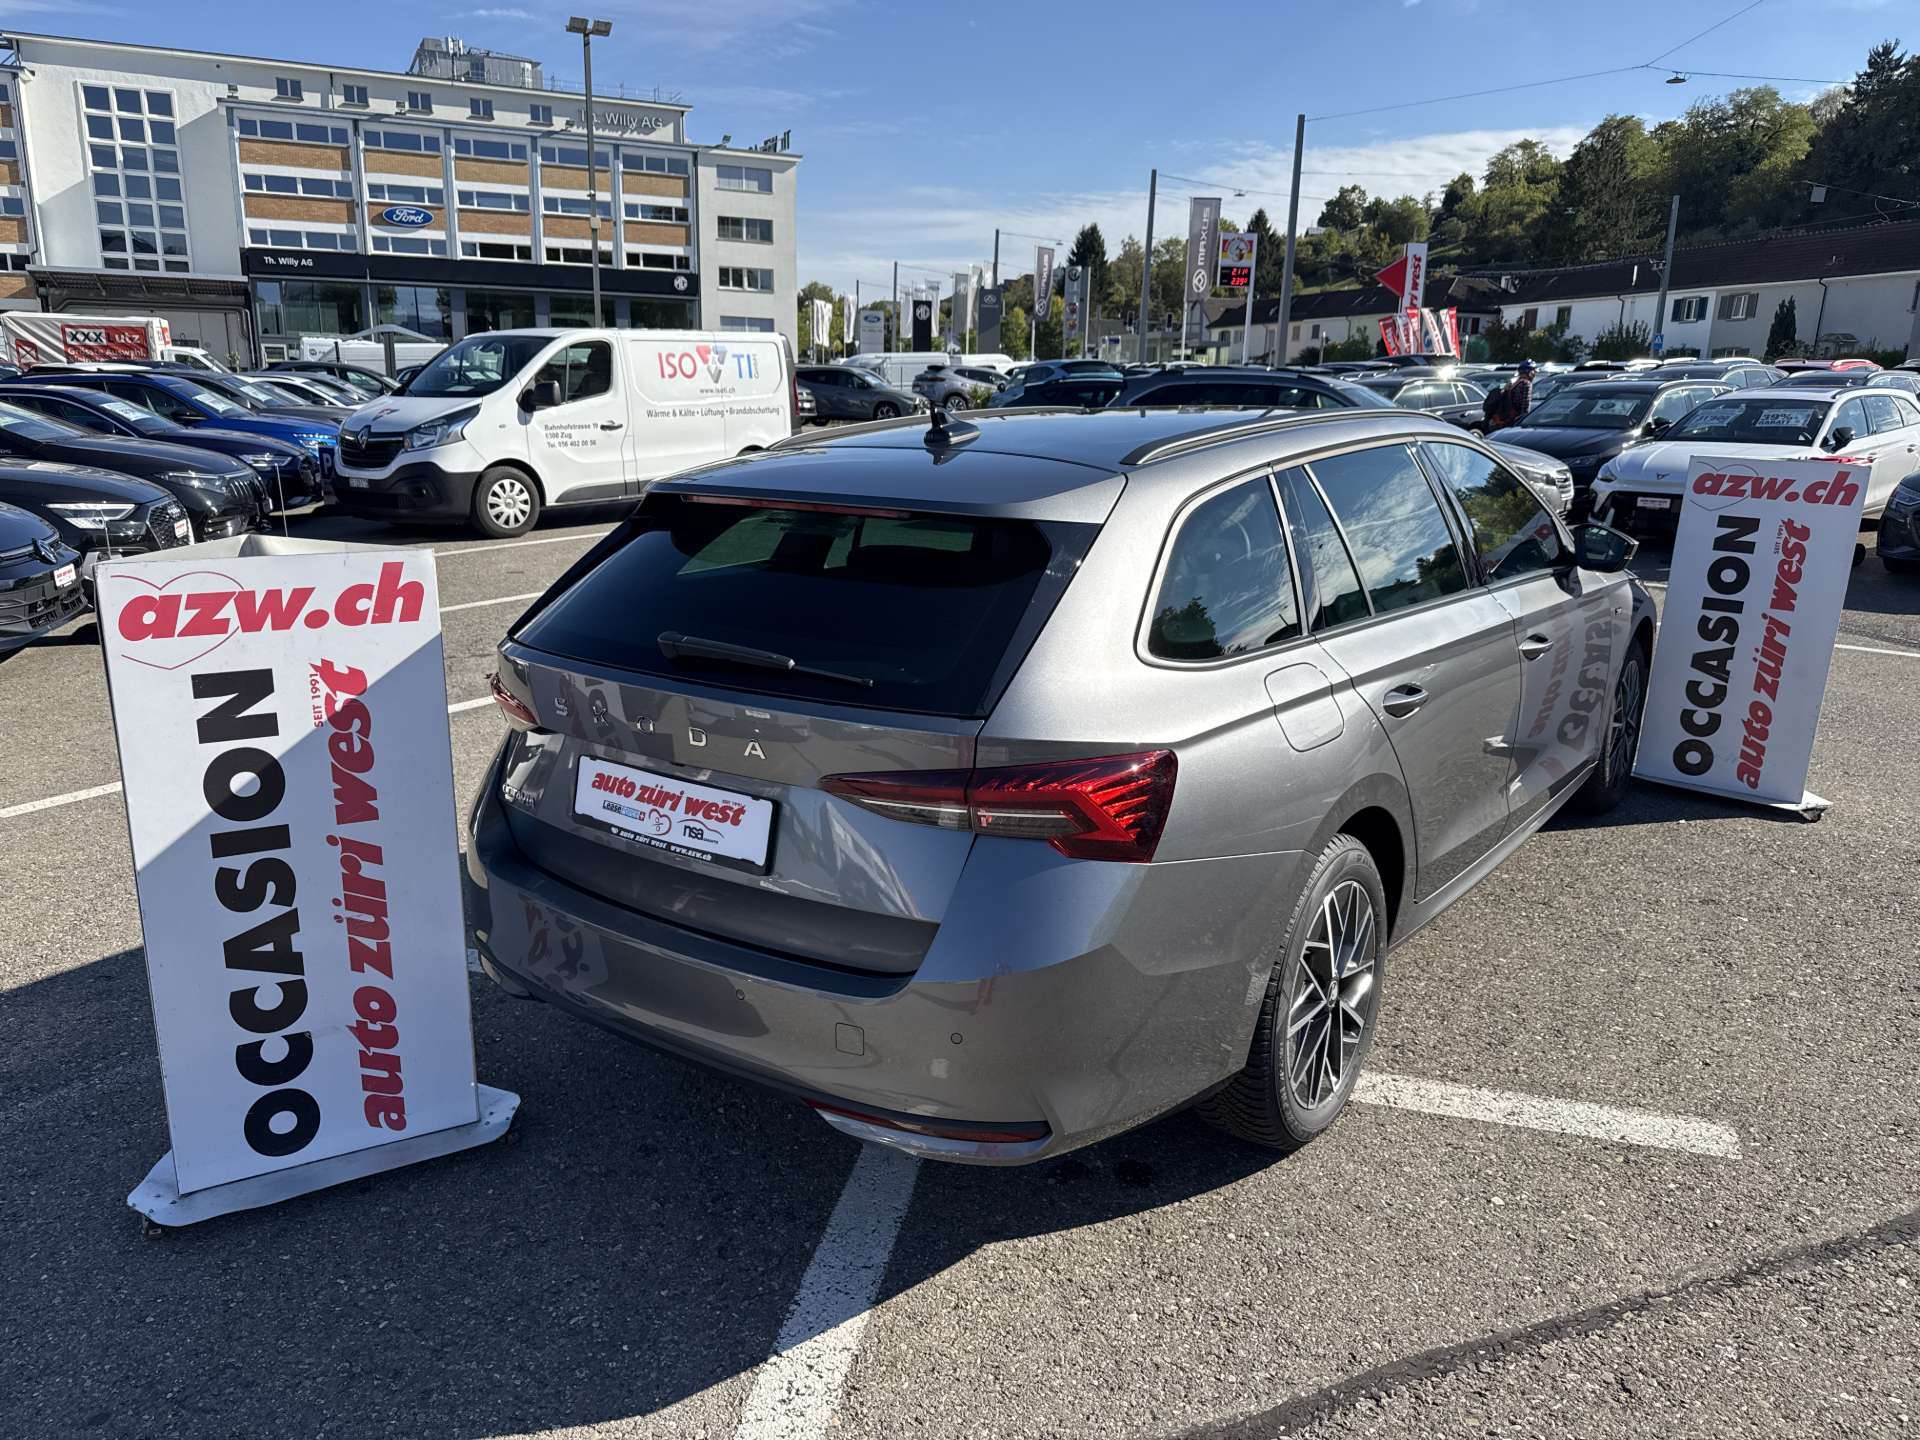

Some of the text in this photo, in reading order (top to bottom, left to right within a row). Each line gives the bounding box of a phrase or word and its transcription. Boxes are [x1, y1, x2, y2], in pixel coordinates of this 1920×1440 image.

[605, 112, 638, 130] Willy
[641, 116, 663, 129] AG
[392, 207, 424, 223] Ford
[264, 256, 313, 268] Th. Willy AG
[657, 351, 698, 379] ISO
[646, 406, 780, 418] Wärme & Kälte Lüftung Brandabschottung
[1692, 471, 1860, 506] azw.ch
[117, 560, 425, 642] azw.ch
[1672, 514, 1761, 777] OCCASION
[1736, 518, 1812, 790] auto züri west
[309, 672, 323, 728] SEIT 1991
[591, 772, 637, 799] auto
[634, 784, 685, 812] züri
[684, 797, 747, 827] west
[619, 830, 635, 840] auto
[651, 840, 668, 849] west
[682, 824, 704, 841] nsa
[309, 658, 408, 1131] auto züri west
[190, 667, 321, 1158] OCCASION
